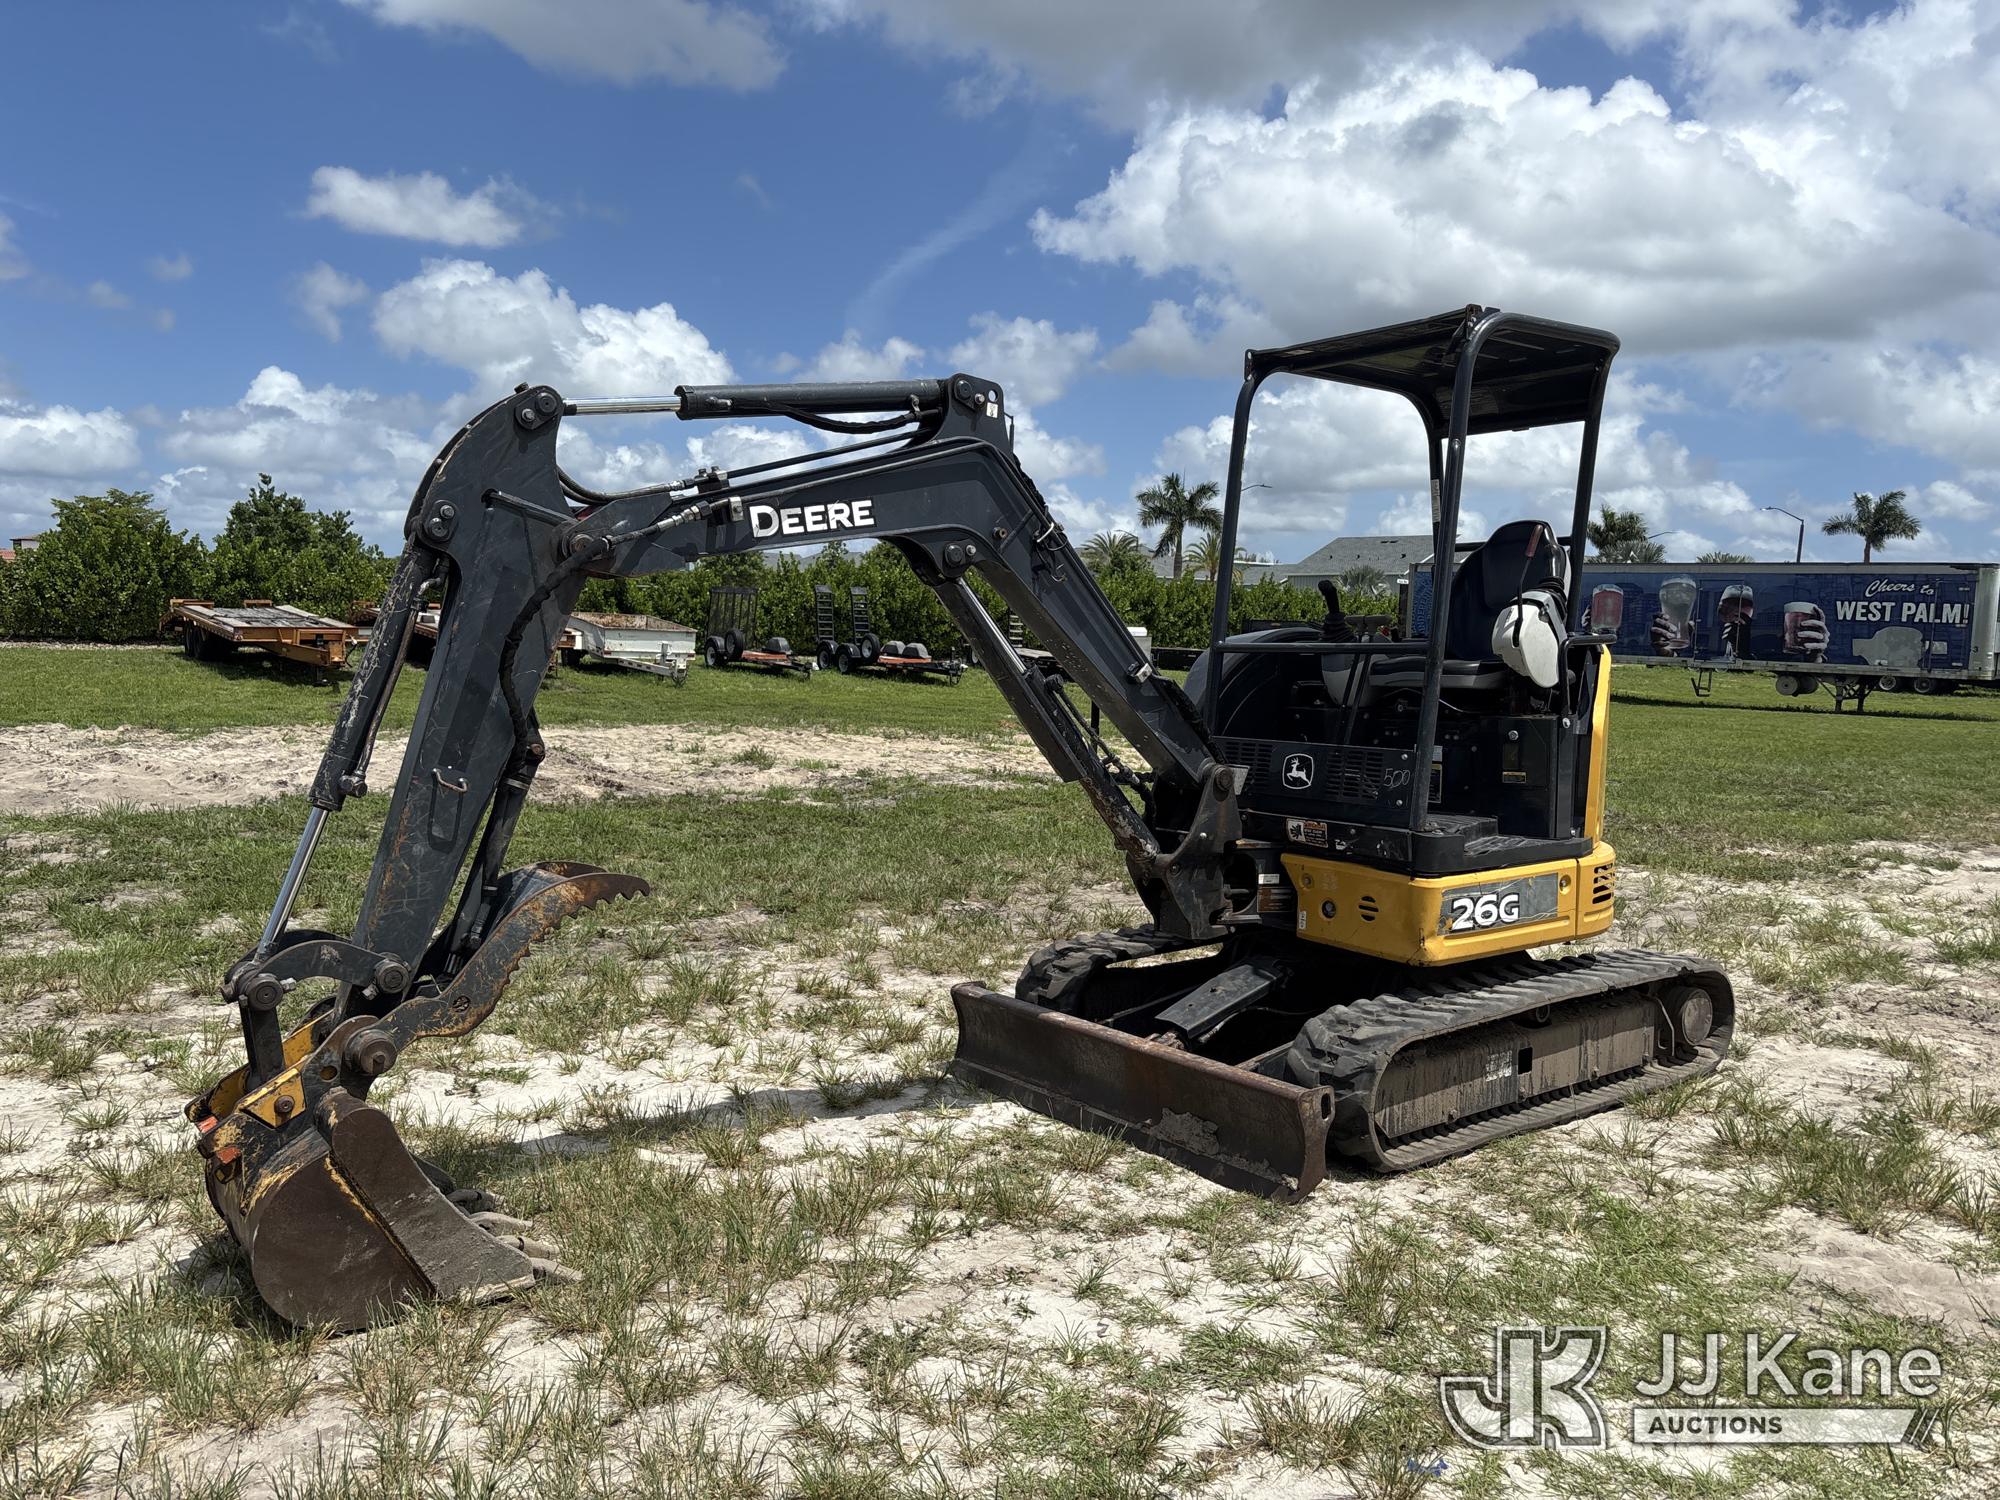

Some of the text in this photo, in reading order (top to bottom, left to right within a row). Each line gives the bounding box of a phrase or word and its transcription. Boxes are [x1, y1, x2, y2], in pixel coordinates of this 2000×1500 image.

[750, 499, 875, 538] DEERE
[1865, 579, 1935, 598] Cheers to
[1836, 601, 1970, 624] WEST PALM!
[1451, 894, 1519, 931] 26G
